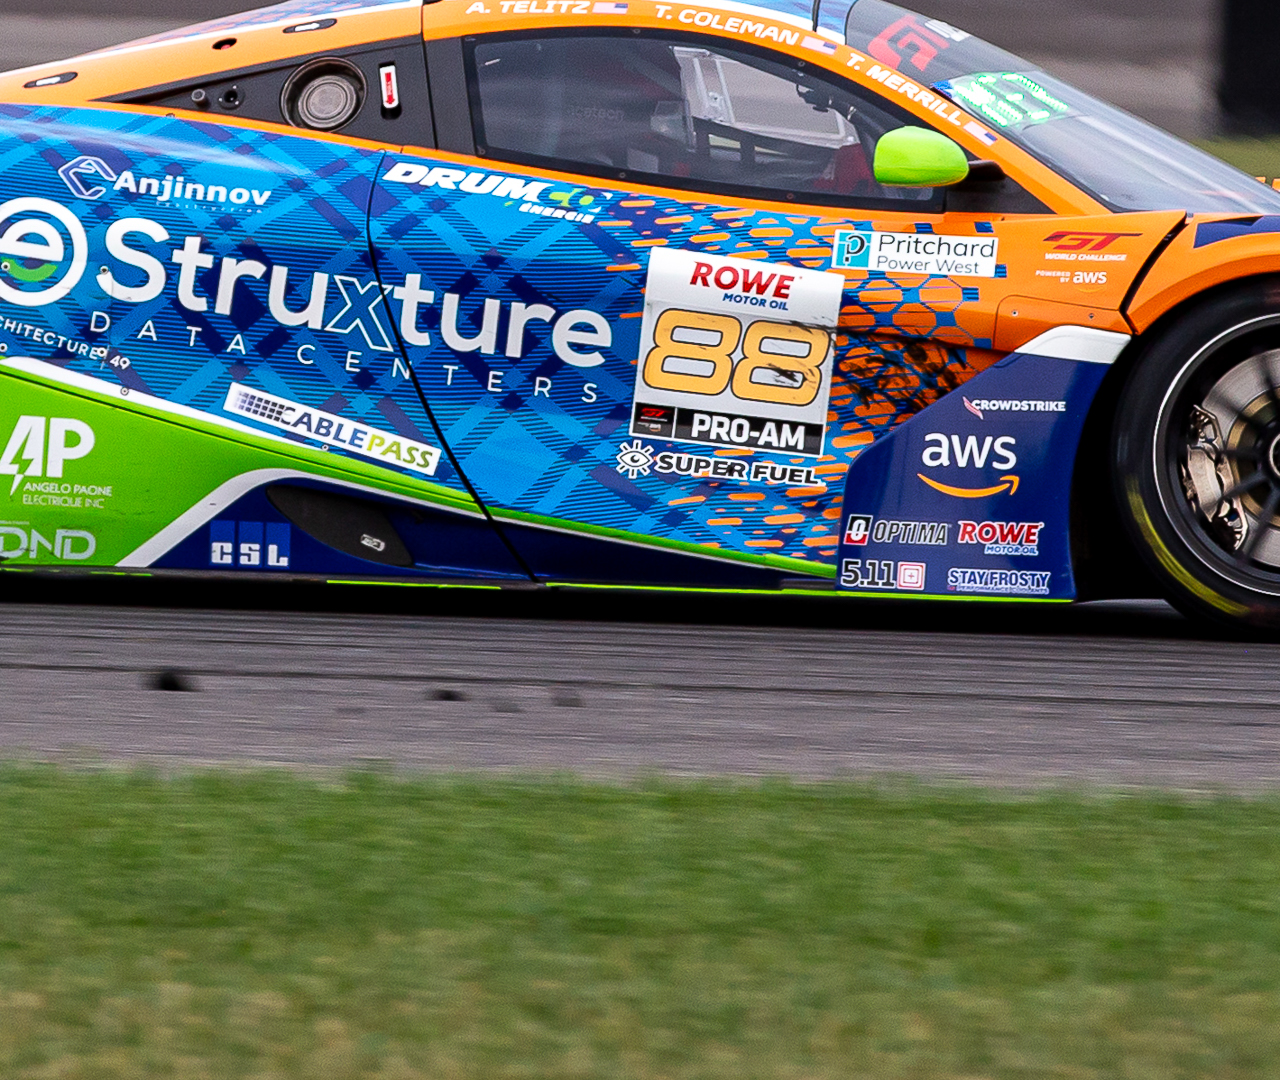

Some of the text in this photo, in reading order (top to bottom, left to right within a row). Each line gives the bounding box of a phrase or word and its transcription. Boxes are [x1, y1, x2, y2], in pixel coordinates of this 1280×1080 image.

[465, 0, 591, 14] A. TELITZ
[655, 4, 800, 45] T. COLEMAN
[846, 52, 866, 70] T.
[866, 64, 965, 127] MERRILL
[113, 170, 272, 206] Anjinnov
[878, 234, 995, 258] Pritchard
[1044, 252, 1127, 262] WORLD CHALLENGE
[876, 255, 980, 275] Power West
[1035, 270, 1071, 278] POWERED
[690, 261, 796, 300] ROWE
[1073, 271, 1107, 284] aws
[722, 292, 789, 311] MOTOR OIL
[90, 311, 598, 404] DATA CENTERS
[110, 355, 131, 370] 49
[642, 307, 834, 408] 88
[971, 399, 1067, 412] CROWDSTRIKE
[281, 406, 434, 469] CABLEPASS
[690, 412, 806, 450] PRO-AM
[921, 432, 1018, 471] aws
[656, 454, 821, 486] SUPER FUEL
[22, 494, 105, 509] ELECTRIQUE INC
[23, 482, 113, 497] ANGELO PAONE
[873, 521, 948, 545] OPTIMA
[958, 521, 1041, 545] ROWE
[211, 541, 289, 567] CSL
[985, 544, 1038, 555] MOTOR OIL
[841, 559, 896, 588] 5.11
[948, 568, 1051, 588] STAY FROSTY
